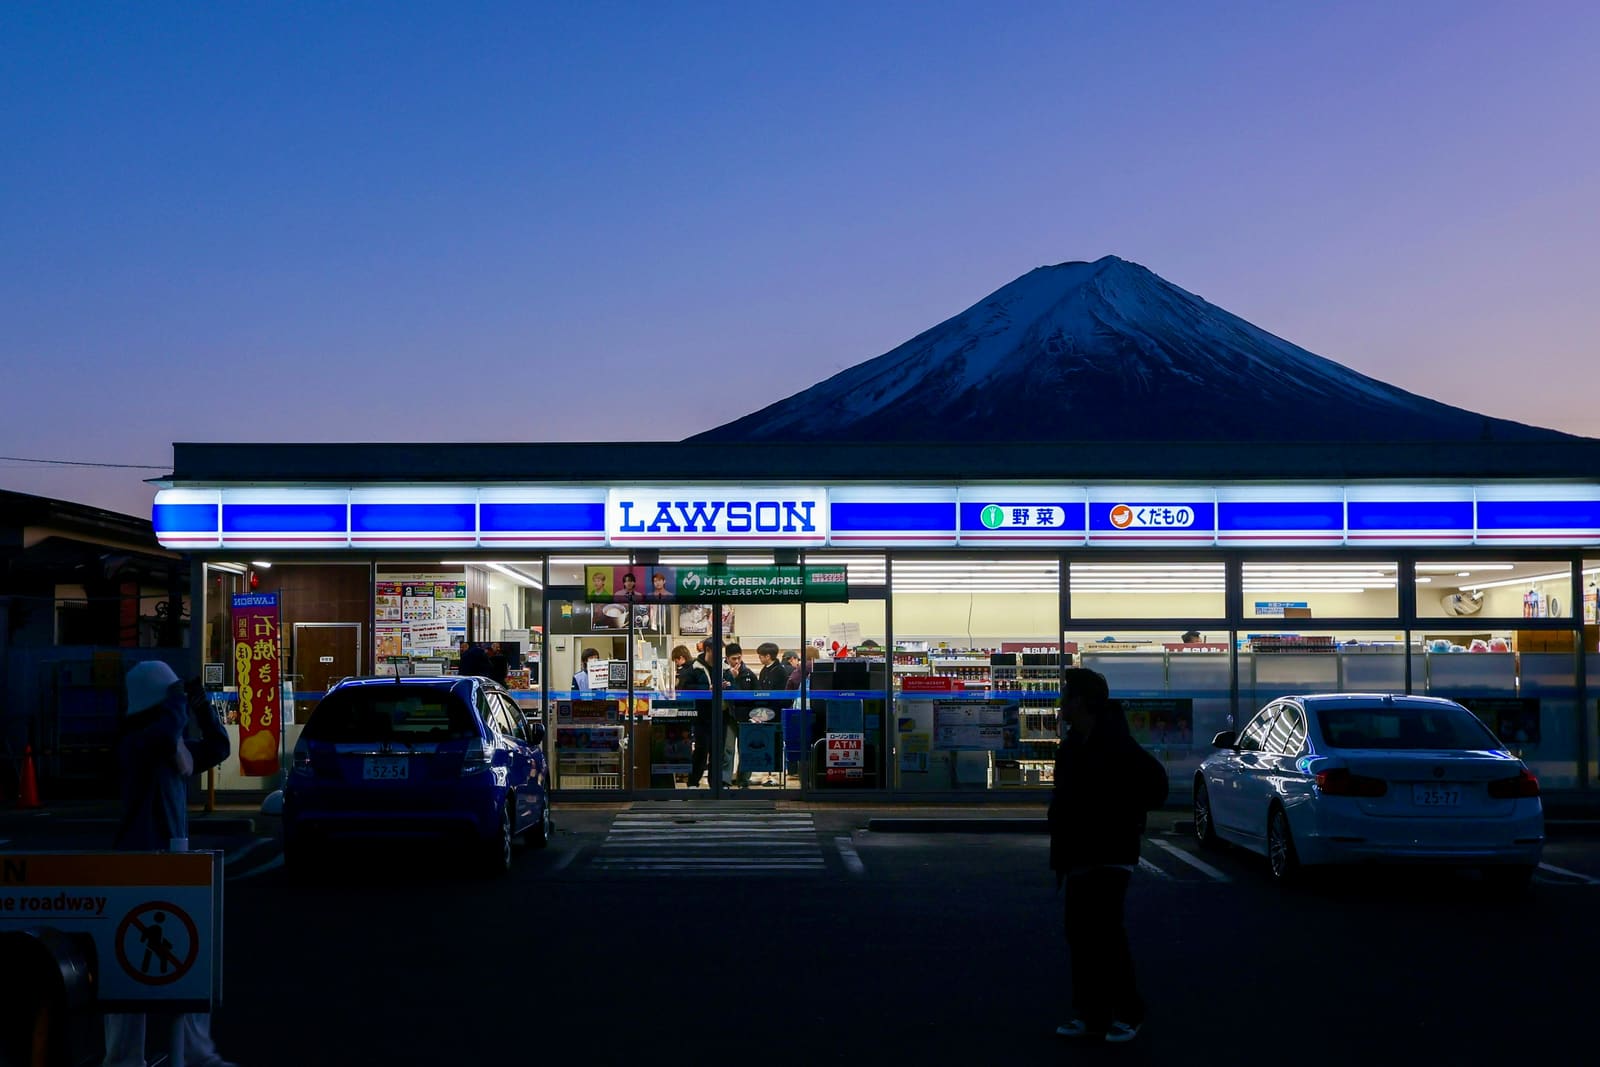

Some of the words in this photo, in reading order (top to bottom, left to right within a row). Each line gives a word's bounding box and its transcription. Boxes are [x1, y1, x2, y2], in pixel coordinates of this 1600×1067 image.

[619, 501, 816, 533] LAWSON
[1012, 508, 1054, 526] 野菜
[1136, 508, 1190, 526] くだもの
[703, 577, 727, 586] Mrs.
[729, 577, 766, 586] GREEN
[768, 577, 804, 586] APPLE
[833, 740, 857, 749] ATM
[1424, 791, 1459, 804] 25-77
[20, 893, 107, 916] roadway
